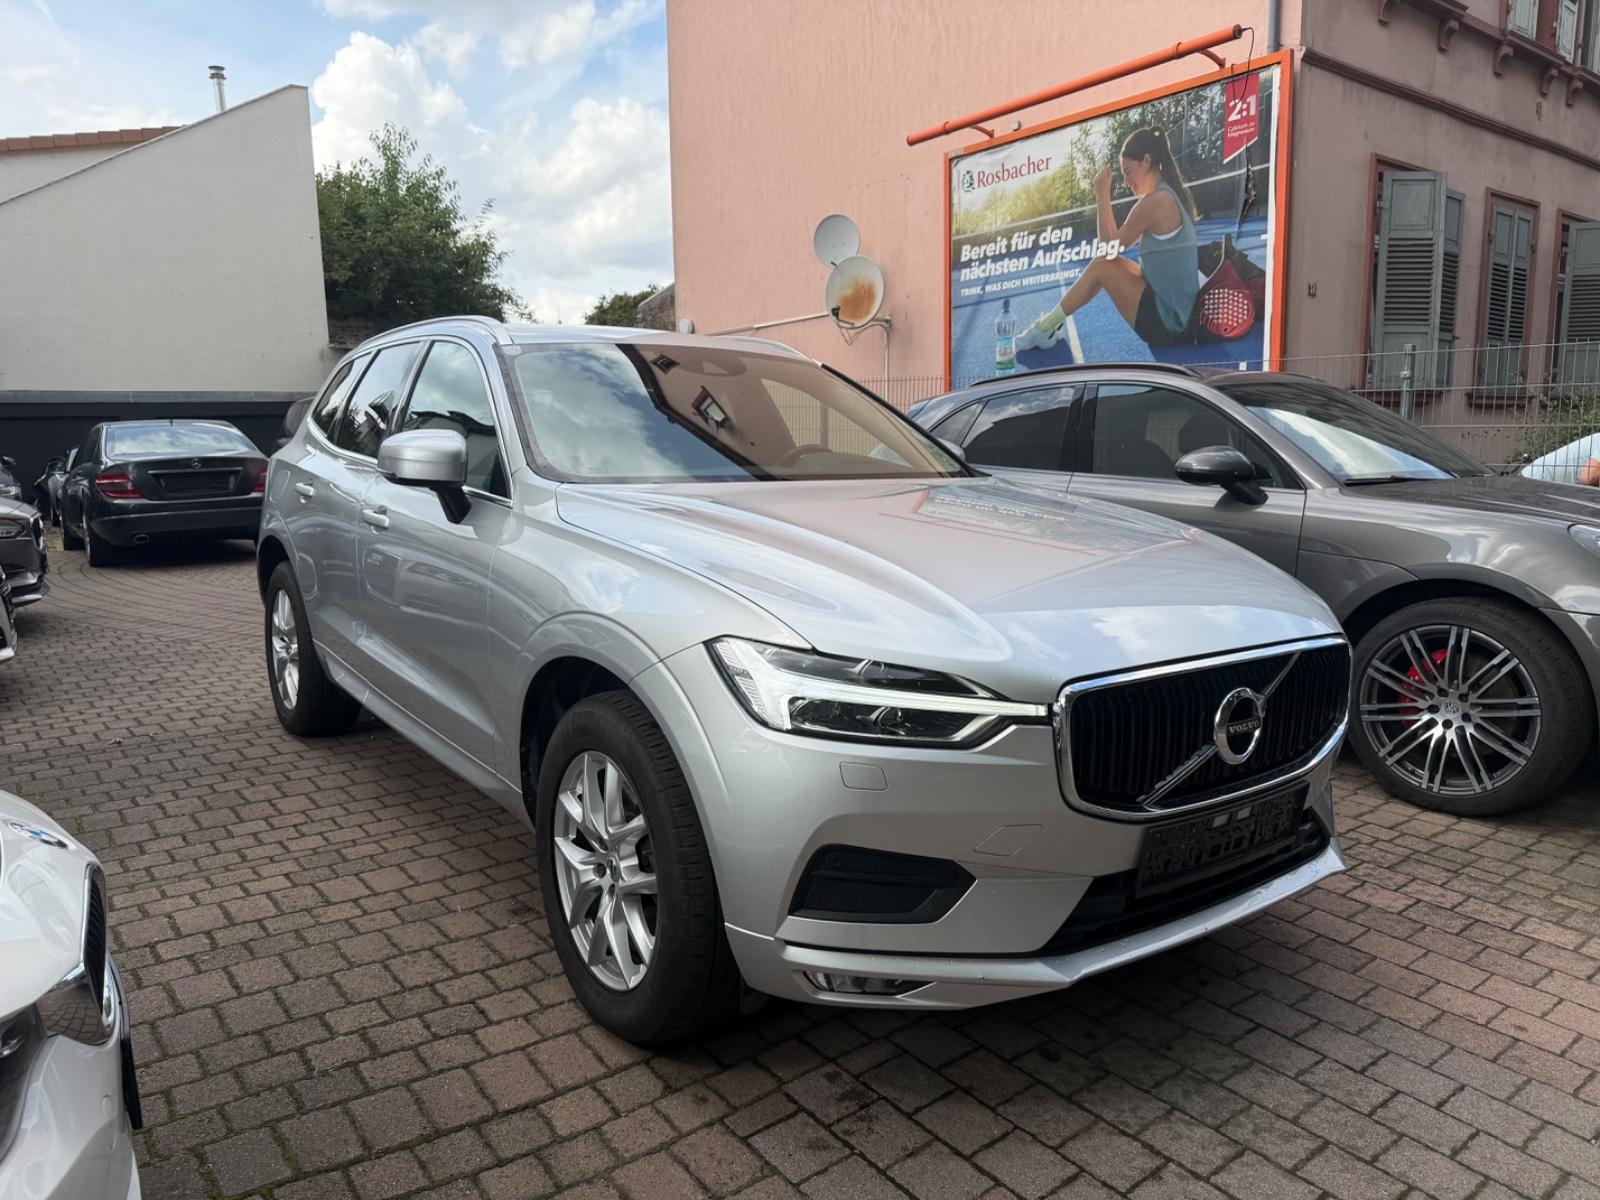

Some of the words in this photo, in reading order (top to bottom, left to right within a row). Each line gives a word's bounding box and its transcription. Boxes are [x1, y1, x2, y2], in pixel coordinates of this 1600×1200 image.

[1228, 94, 1256, 122] 2:1
[977, 155, 1052, 188] Rosbacher
[960, 239, 1007, 262] Bereit
[1010, 231, 1036, 252] für
[1039, 225, 1072, 246] den
[960, 256, 1029, 281] nächsten
[1032, 238, 1125, 269] Aufschlag.
[985, 281, 1002, 293] WAS
[1002, 278, 1021, 290] DICH
[1228, 720, 1259, 733] VOLVO
